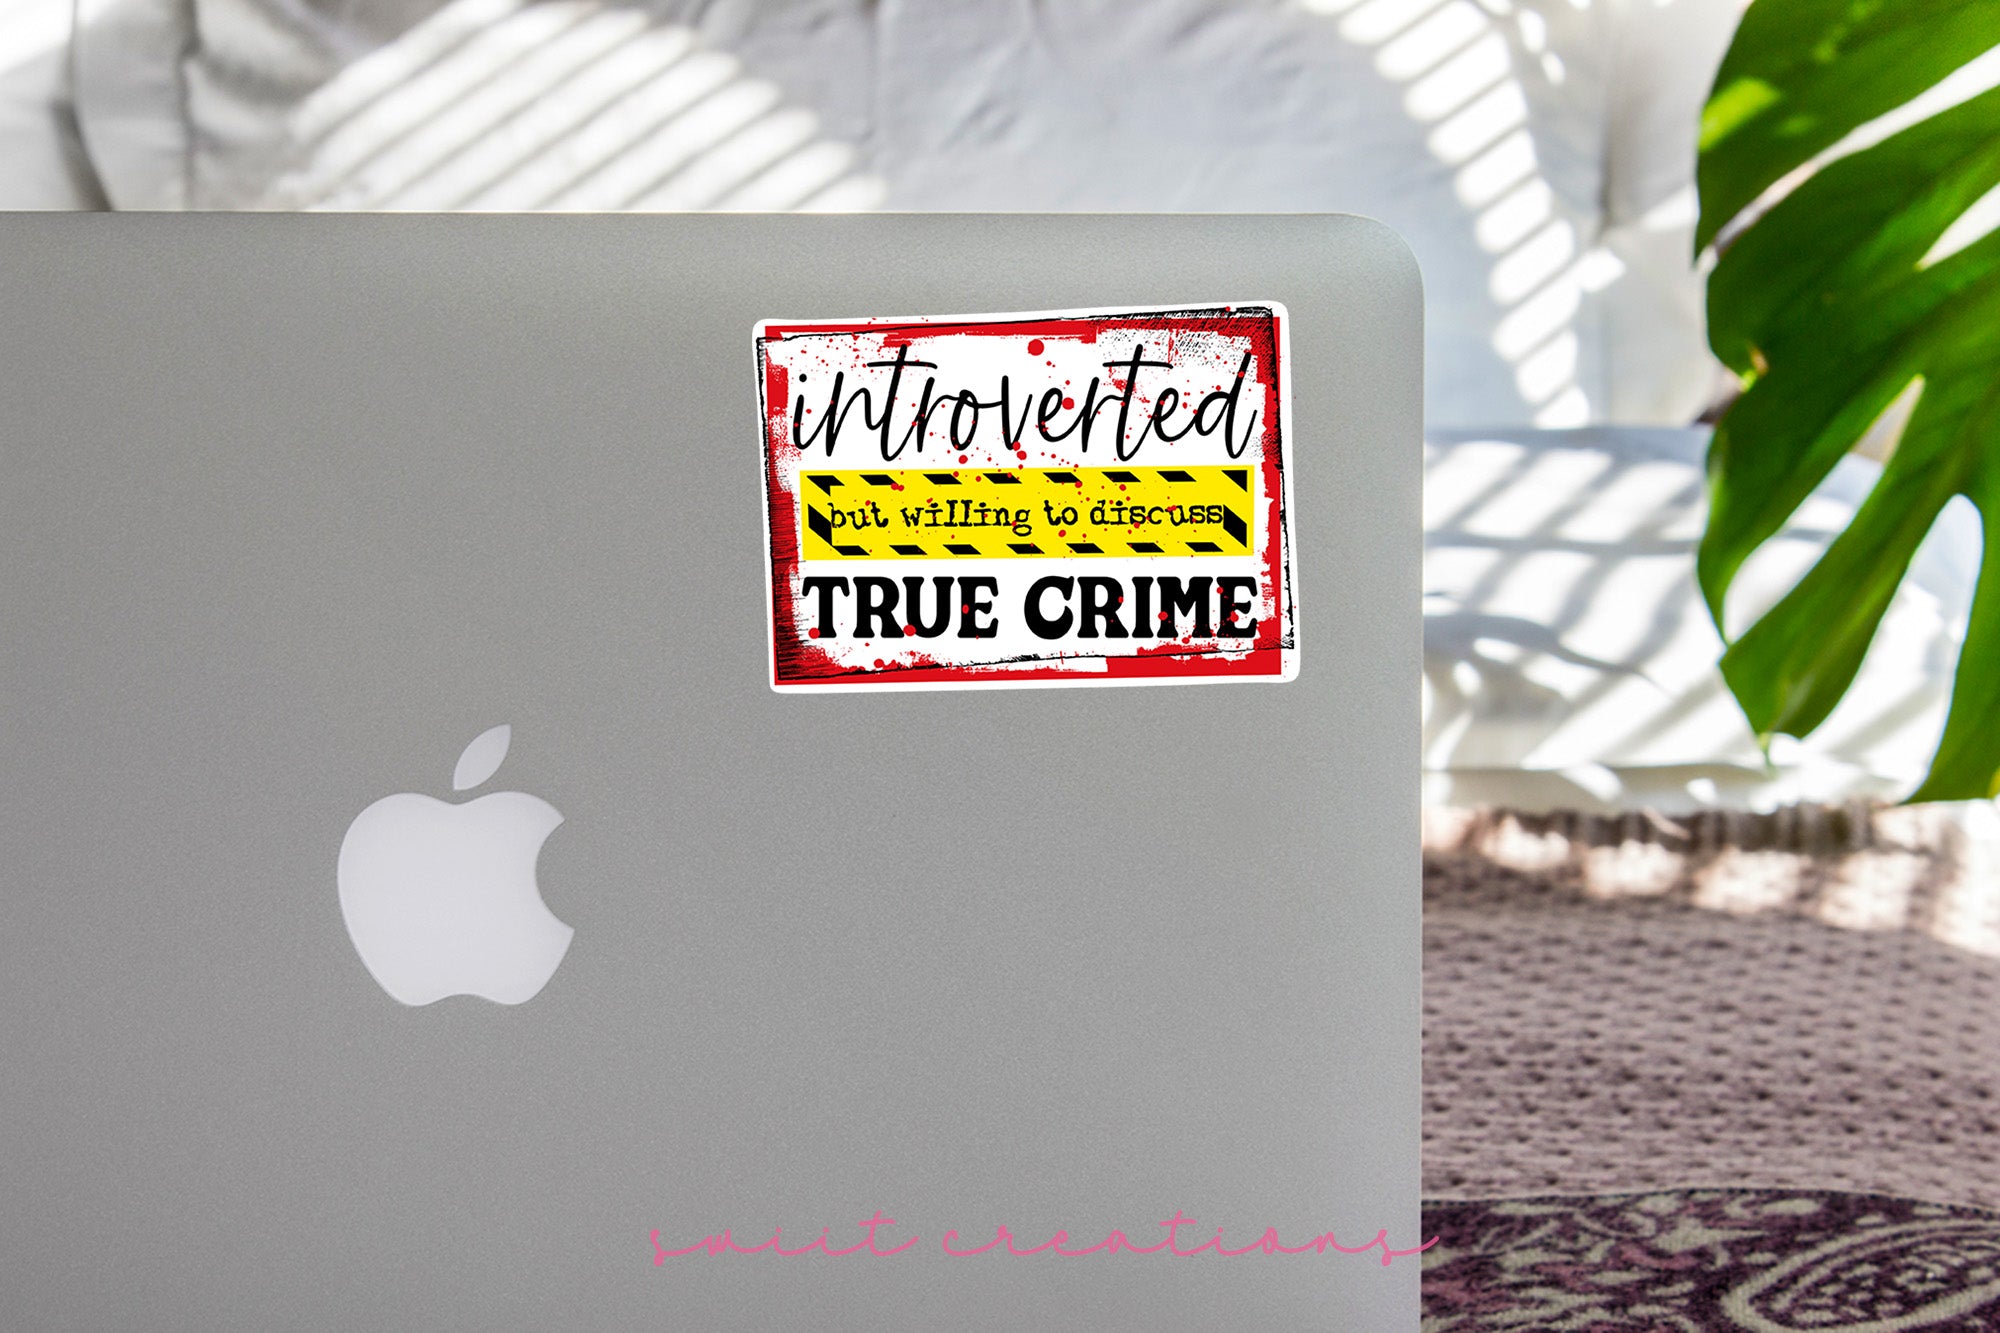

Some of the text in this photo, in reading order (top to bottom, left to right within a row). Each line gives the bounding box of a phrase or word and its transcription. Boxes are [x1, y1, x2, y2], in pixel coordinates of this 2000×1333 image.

[793, 344, 1258, 461] introverted
[831, 497, 1225, 537] but willing to discuss
[802, 575, 1258, 640] TRUE CRIME
